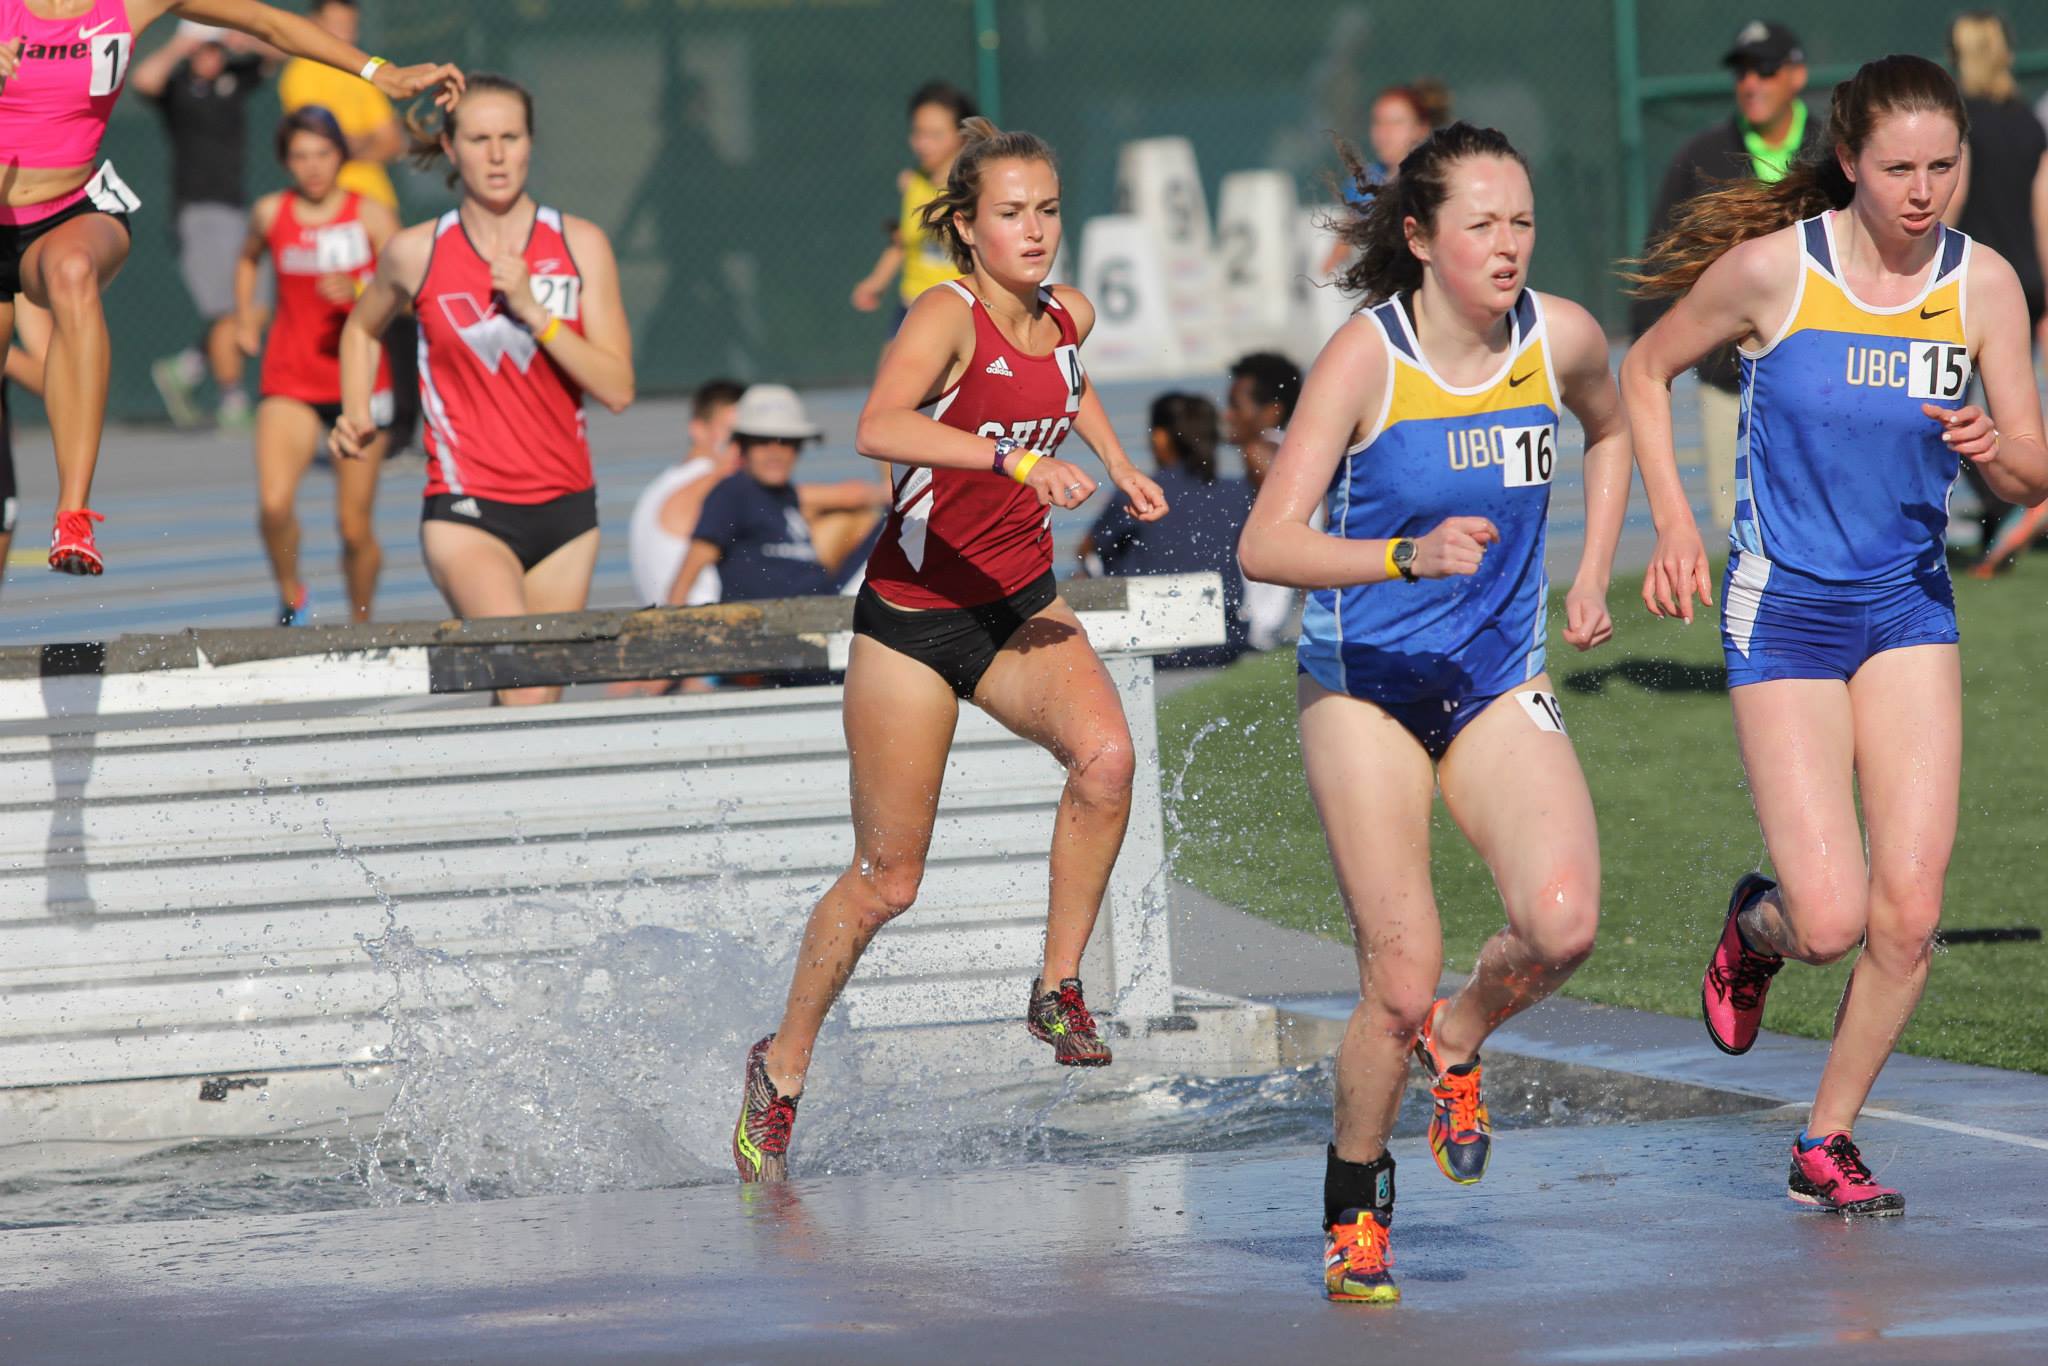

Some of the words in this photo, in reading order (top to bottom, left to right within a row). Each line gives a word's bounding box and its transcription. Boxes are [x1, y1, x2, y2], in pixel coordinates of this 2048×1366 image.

[17, 35, 92, 61] jane
[103, 38, 119, 90] 1
[538, 279, 571, 315] 21
[1099, 256, 1140, 322] 6
[985, 366, 1014, 377] adidas
[1847, 346, 1908, 388] UBC
[1922, 345, 1967, 397] 15
[1447, 425, 1504, 471] UBC
[1515, 428, 1553, 482] 16
